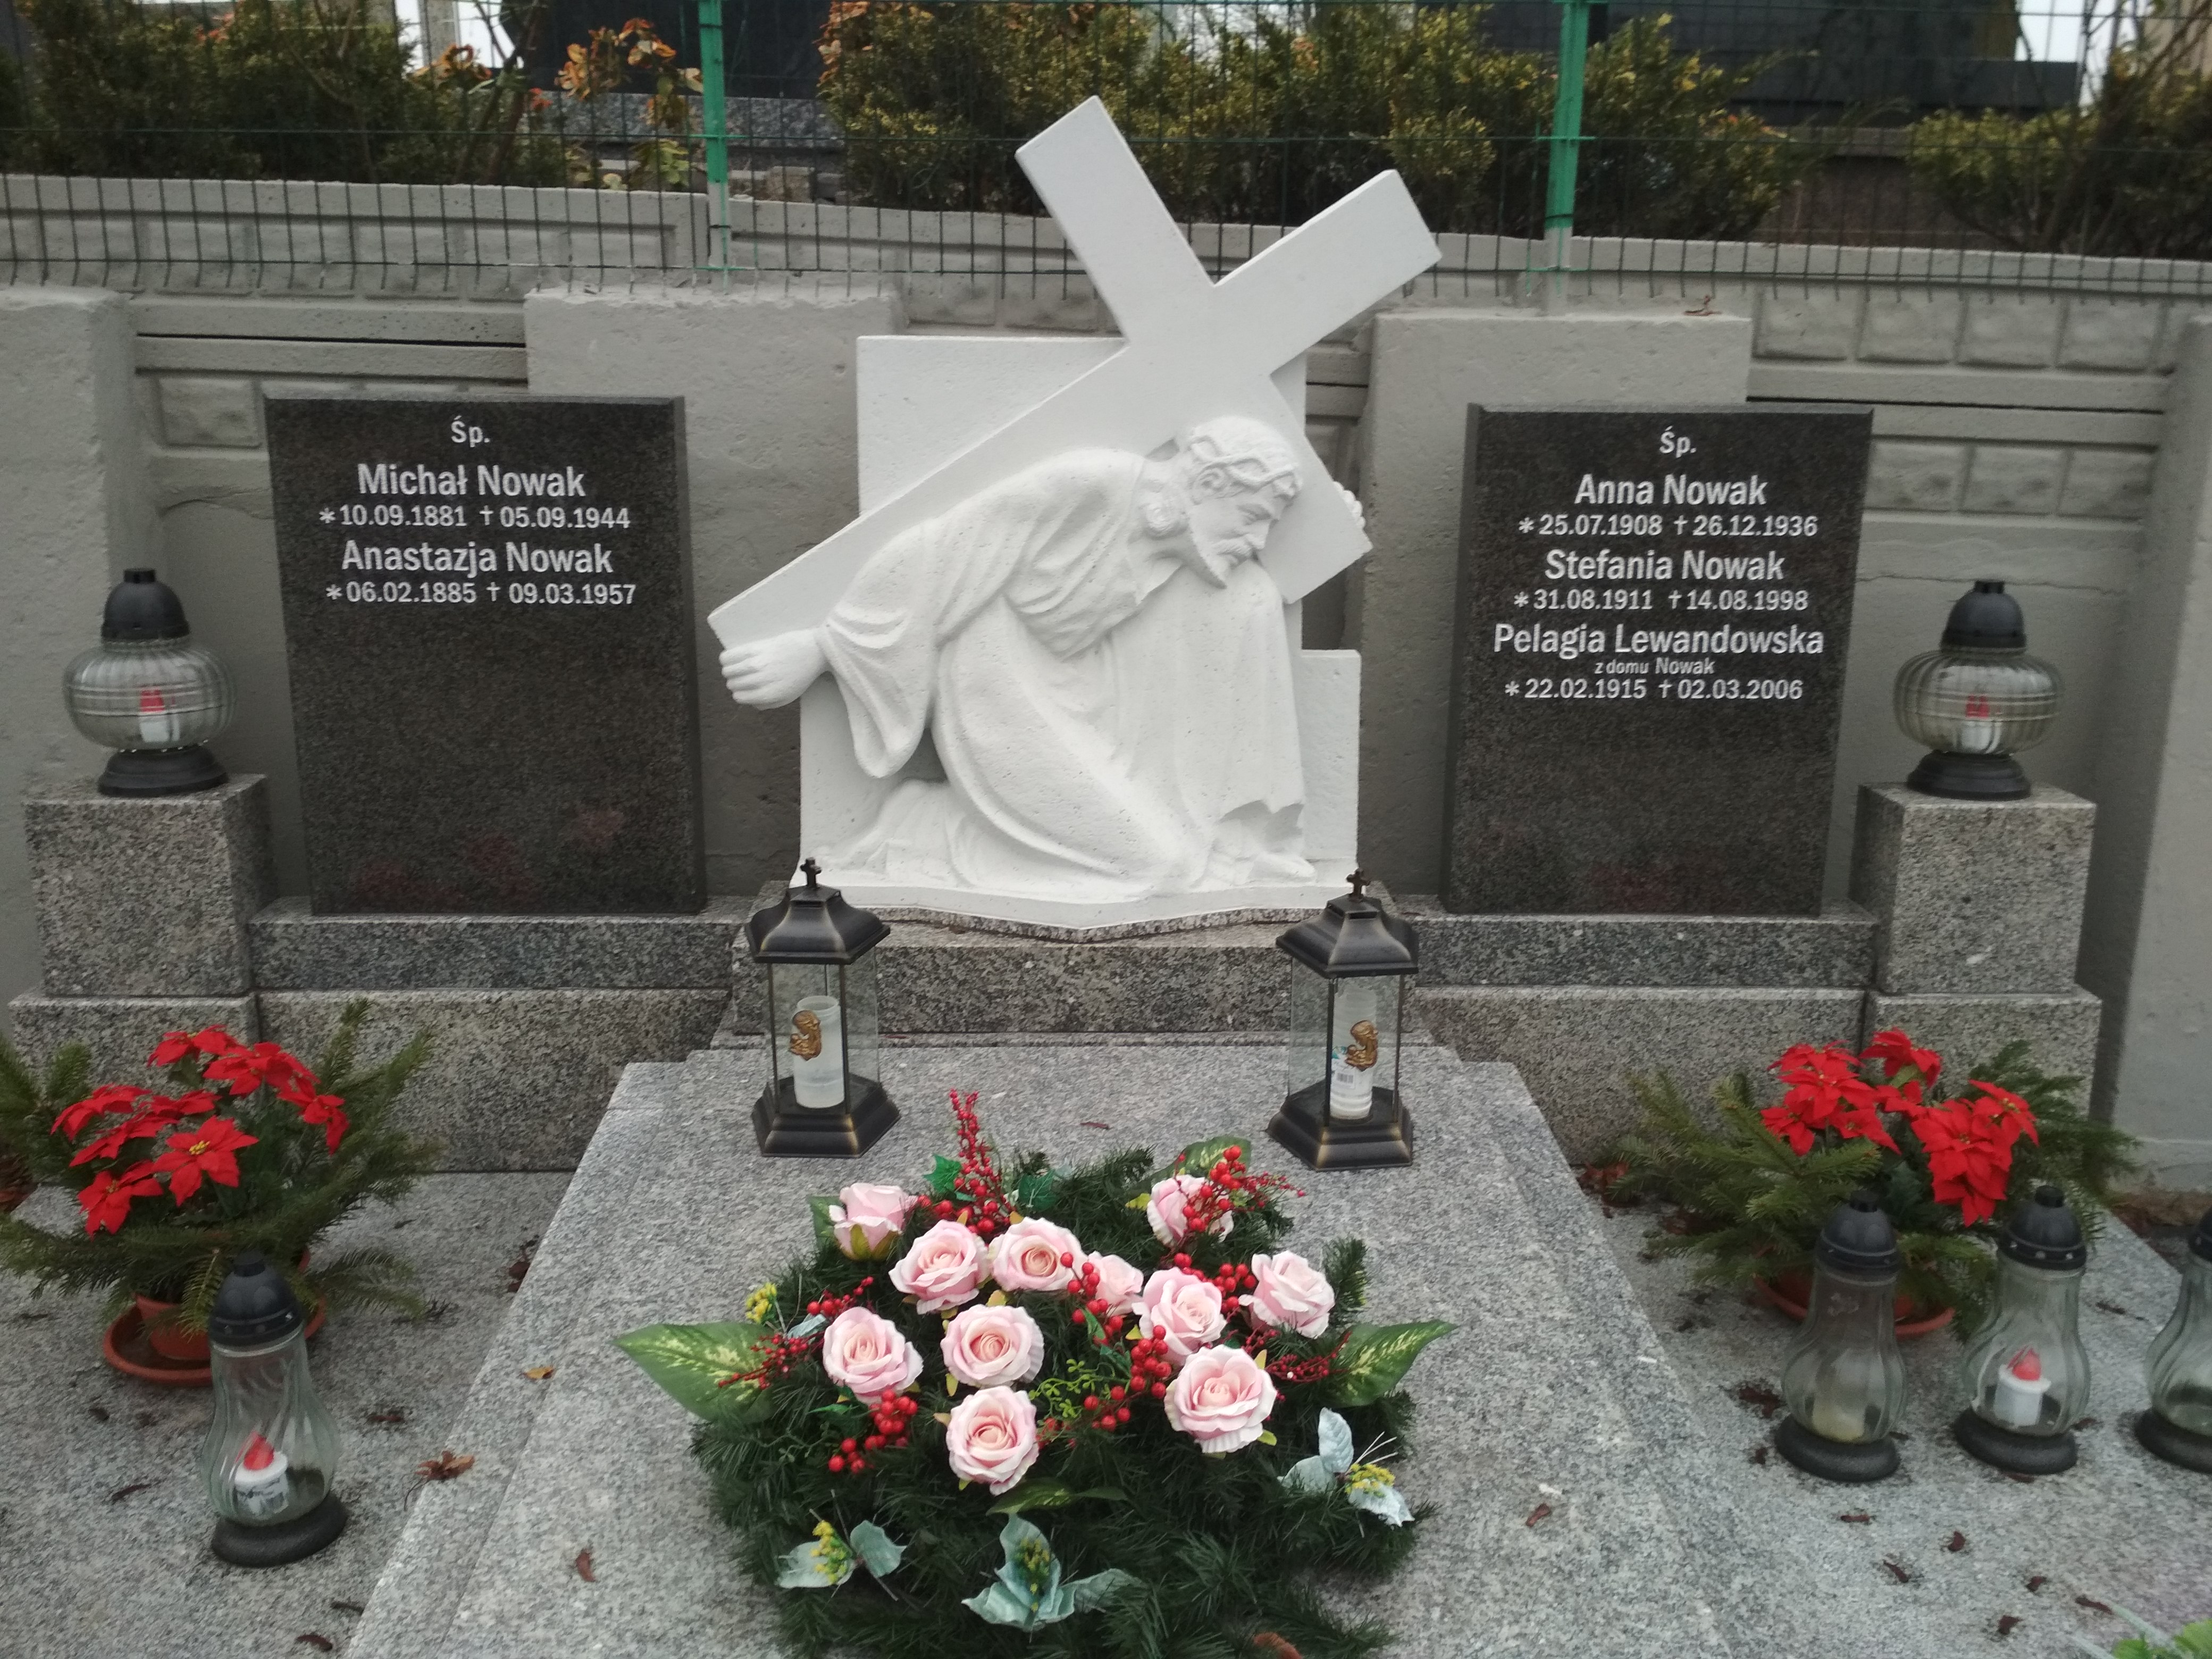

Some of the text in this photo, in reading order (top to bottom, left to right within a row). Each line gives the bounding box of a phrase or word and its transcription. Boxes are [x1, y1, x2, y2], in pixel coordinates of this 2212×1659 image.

[451, 415, 490, 448] Śp.
[1659, 425, 1696, 458] Śp.
[357, 463, 586, 497] Michał Nowak
[1574, 473, 1768, 506] Anna Nowak
[339, 504, 631, 529] 10.09.1881 05.09.1944
[1538, 514, 1818, 537] 25.07.1908 26.12.1936
[342, 540, 614, 579] Anastazja Nowak
[1545, 548, 1785, 581] Stefania Nowak
[346, 581, 636, 605] 06.02.1885 09.03.1957
[1533, 588, 1809, 611] 31.08.1911 14.08.1998
[1494, 623, 1824, 660] Pelagia Lewandowska
[1594, 657, 1715, 675] z domu Nowak
[1524, 677, 1803, 700] 22.02.1915 02.03.2006
